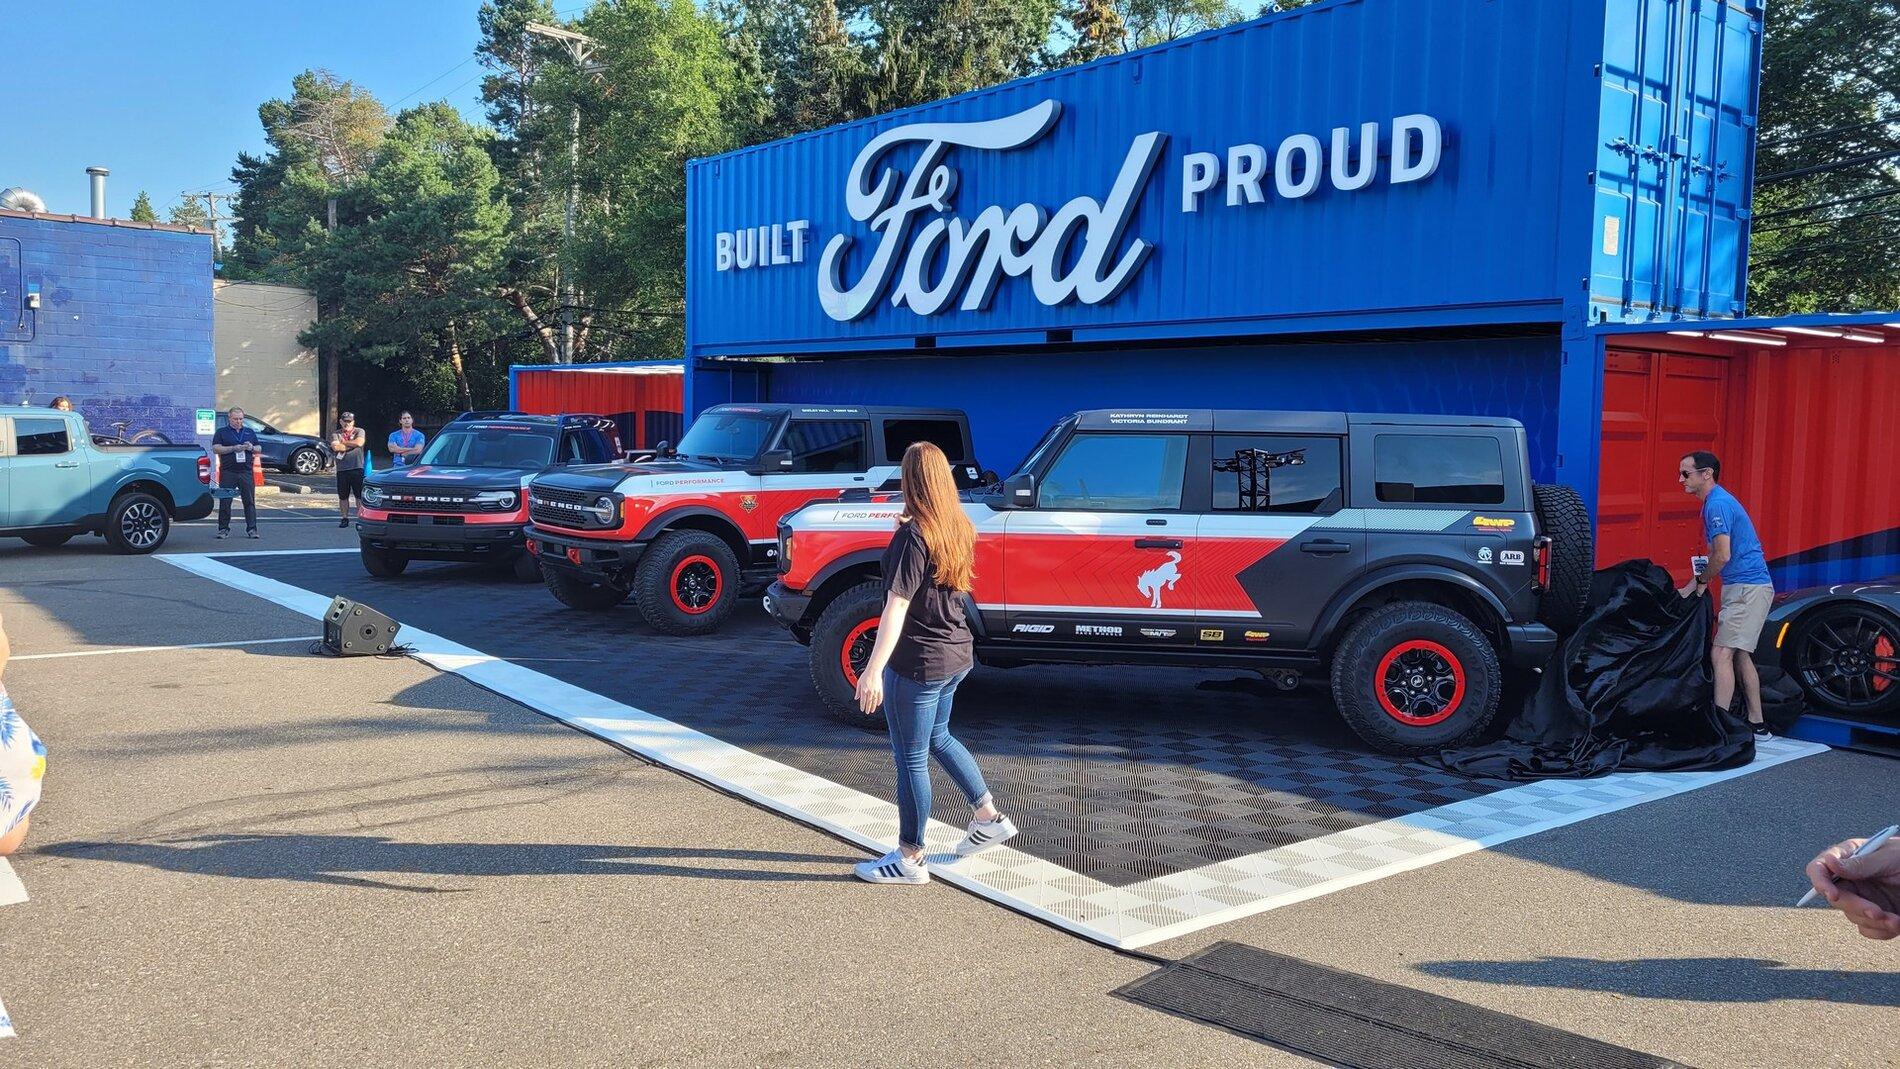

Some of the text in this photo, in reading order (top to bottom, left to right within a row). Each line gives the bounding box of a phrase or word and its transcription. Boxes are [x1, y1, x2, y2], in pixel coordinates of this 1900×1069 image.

[716, 99, 1443, 321] BUILT Ford PROUD
[391, 495, 464, 503] BRONCO
[537, 499, 582, 511] BRONCO
[1012, 624, 1055, 633] RIGID
[1075, 624, 1123, 633] METHOD
